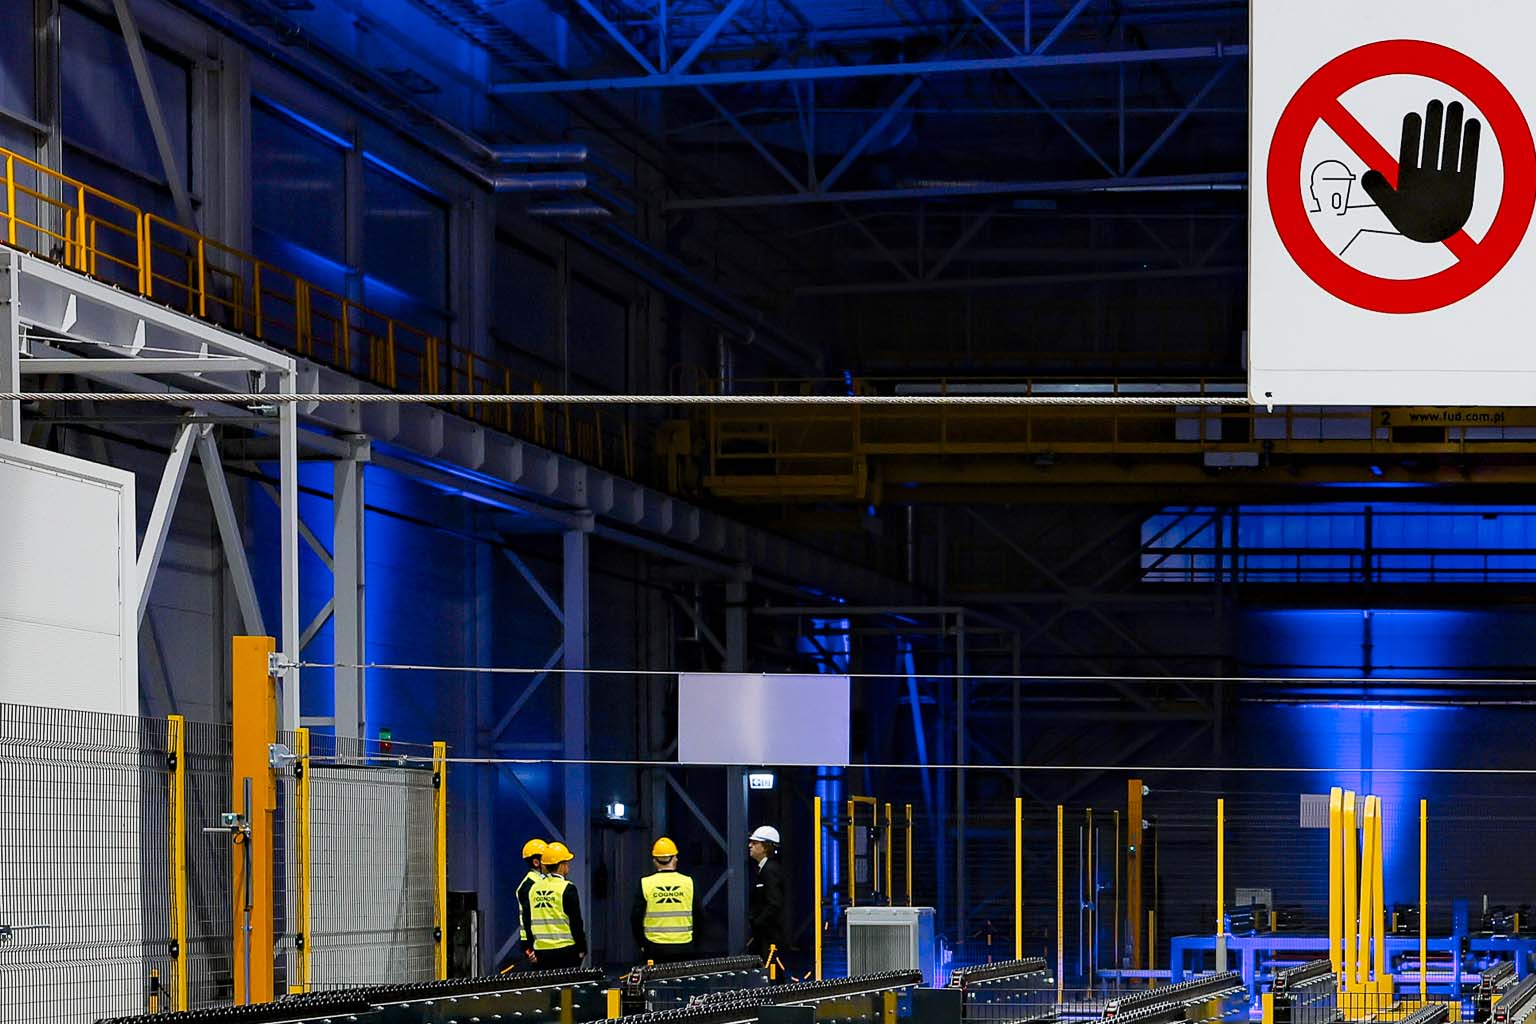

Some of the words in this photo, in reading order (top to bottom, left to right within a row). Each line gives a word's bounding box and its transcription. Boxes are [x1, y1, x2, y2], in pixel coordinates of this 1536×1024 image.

[1381, 411, 1391, 425] 2
[1409, 411, 1505, 424] www.fud.com.pl
[652, 891, 684, 899] COGNOR
